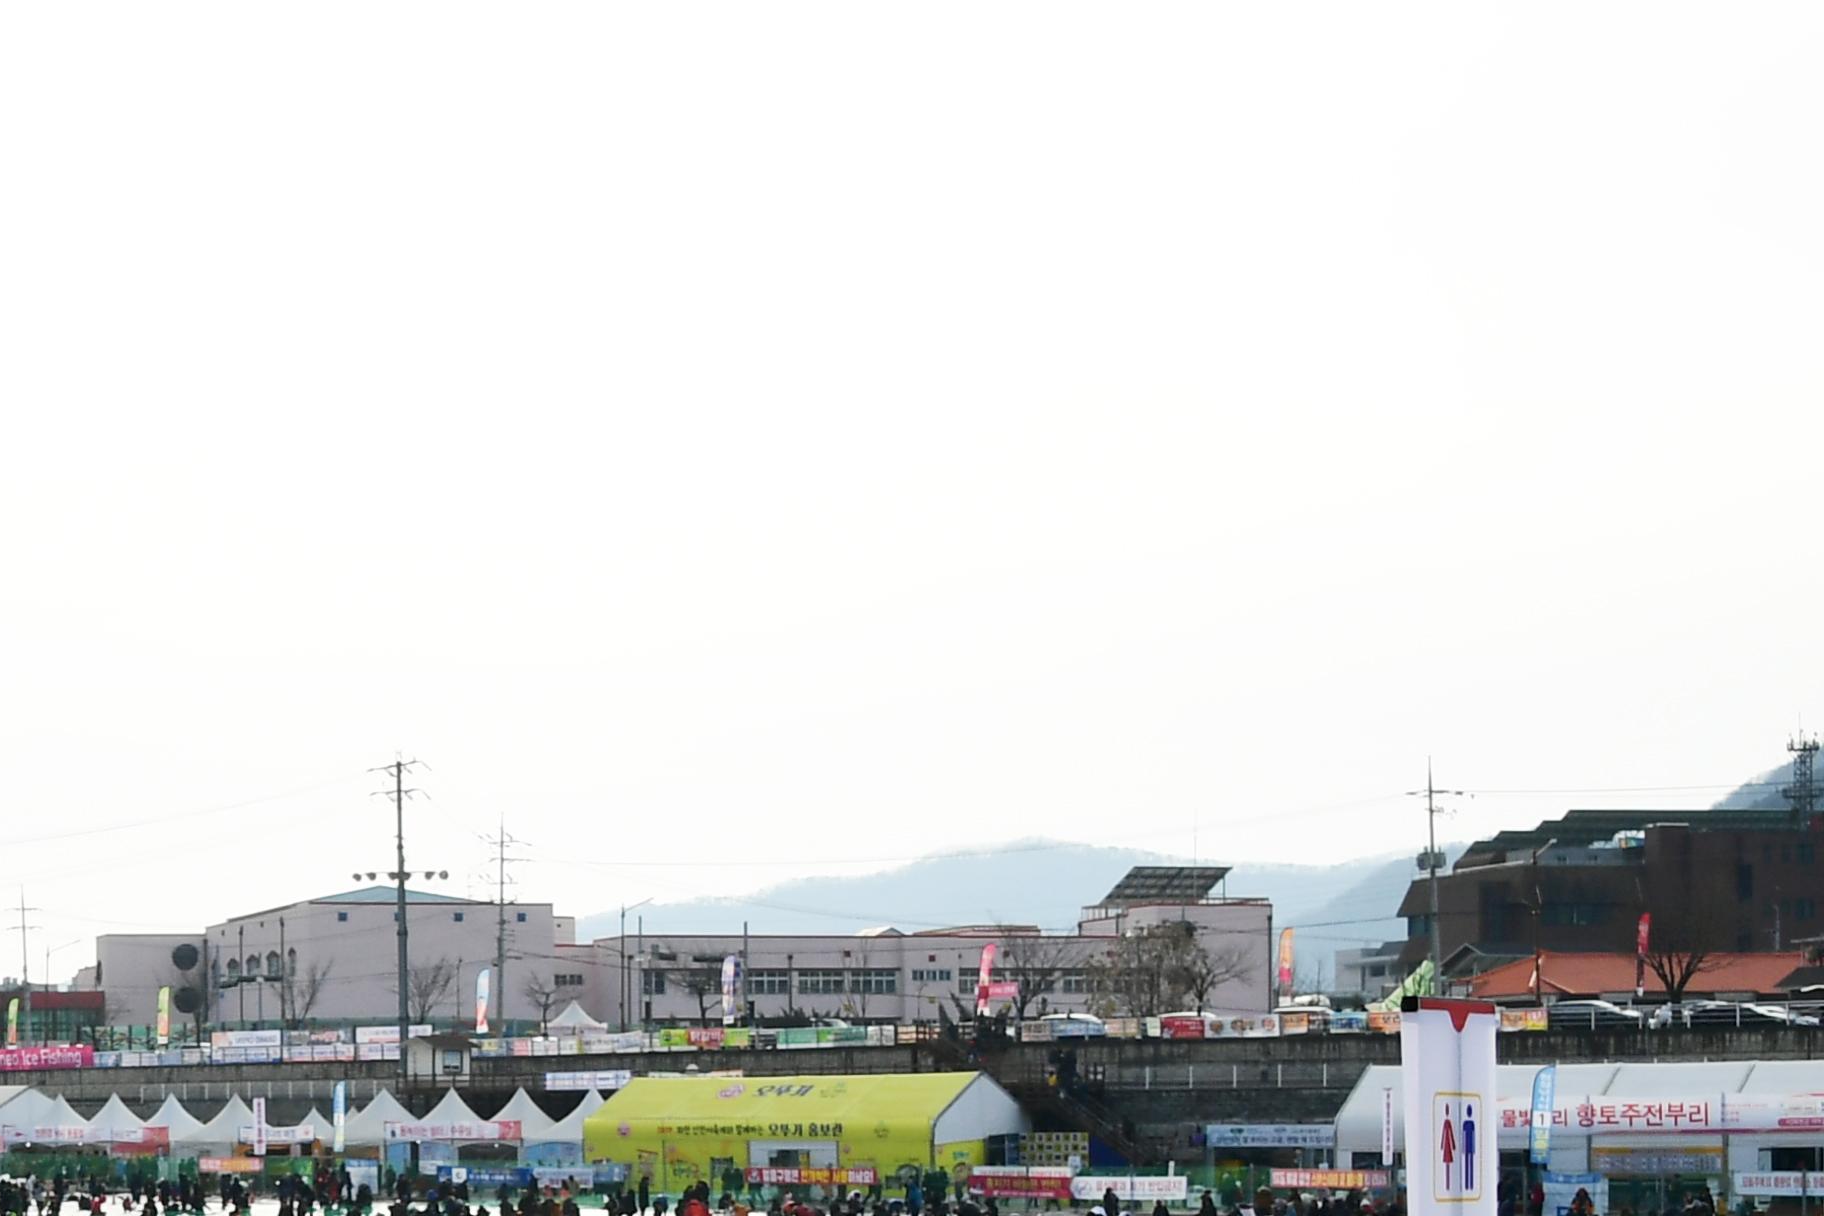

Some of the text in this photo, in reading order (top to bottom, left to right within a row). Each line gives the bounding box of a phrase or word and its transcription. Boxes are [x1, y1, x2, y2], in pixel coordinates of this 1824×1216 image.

[39, 1048, 82, 1068] Fishing
[1500, 1103, 1710, 1128] 물빛리 향토주전부리
